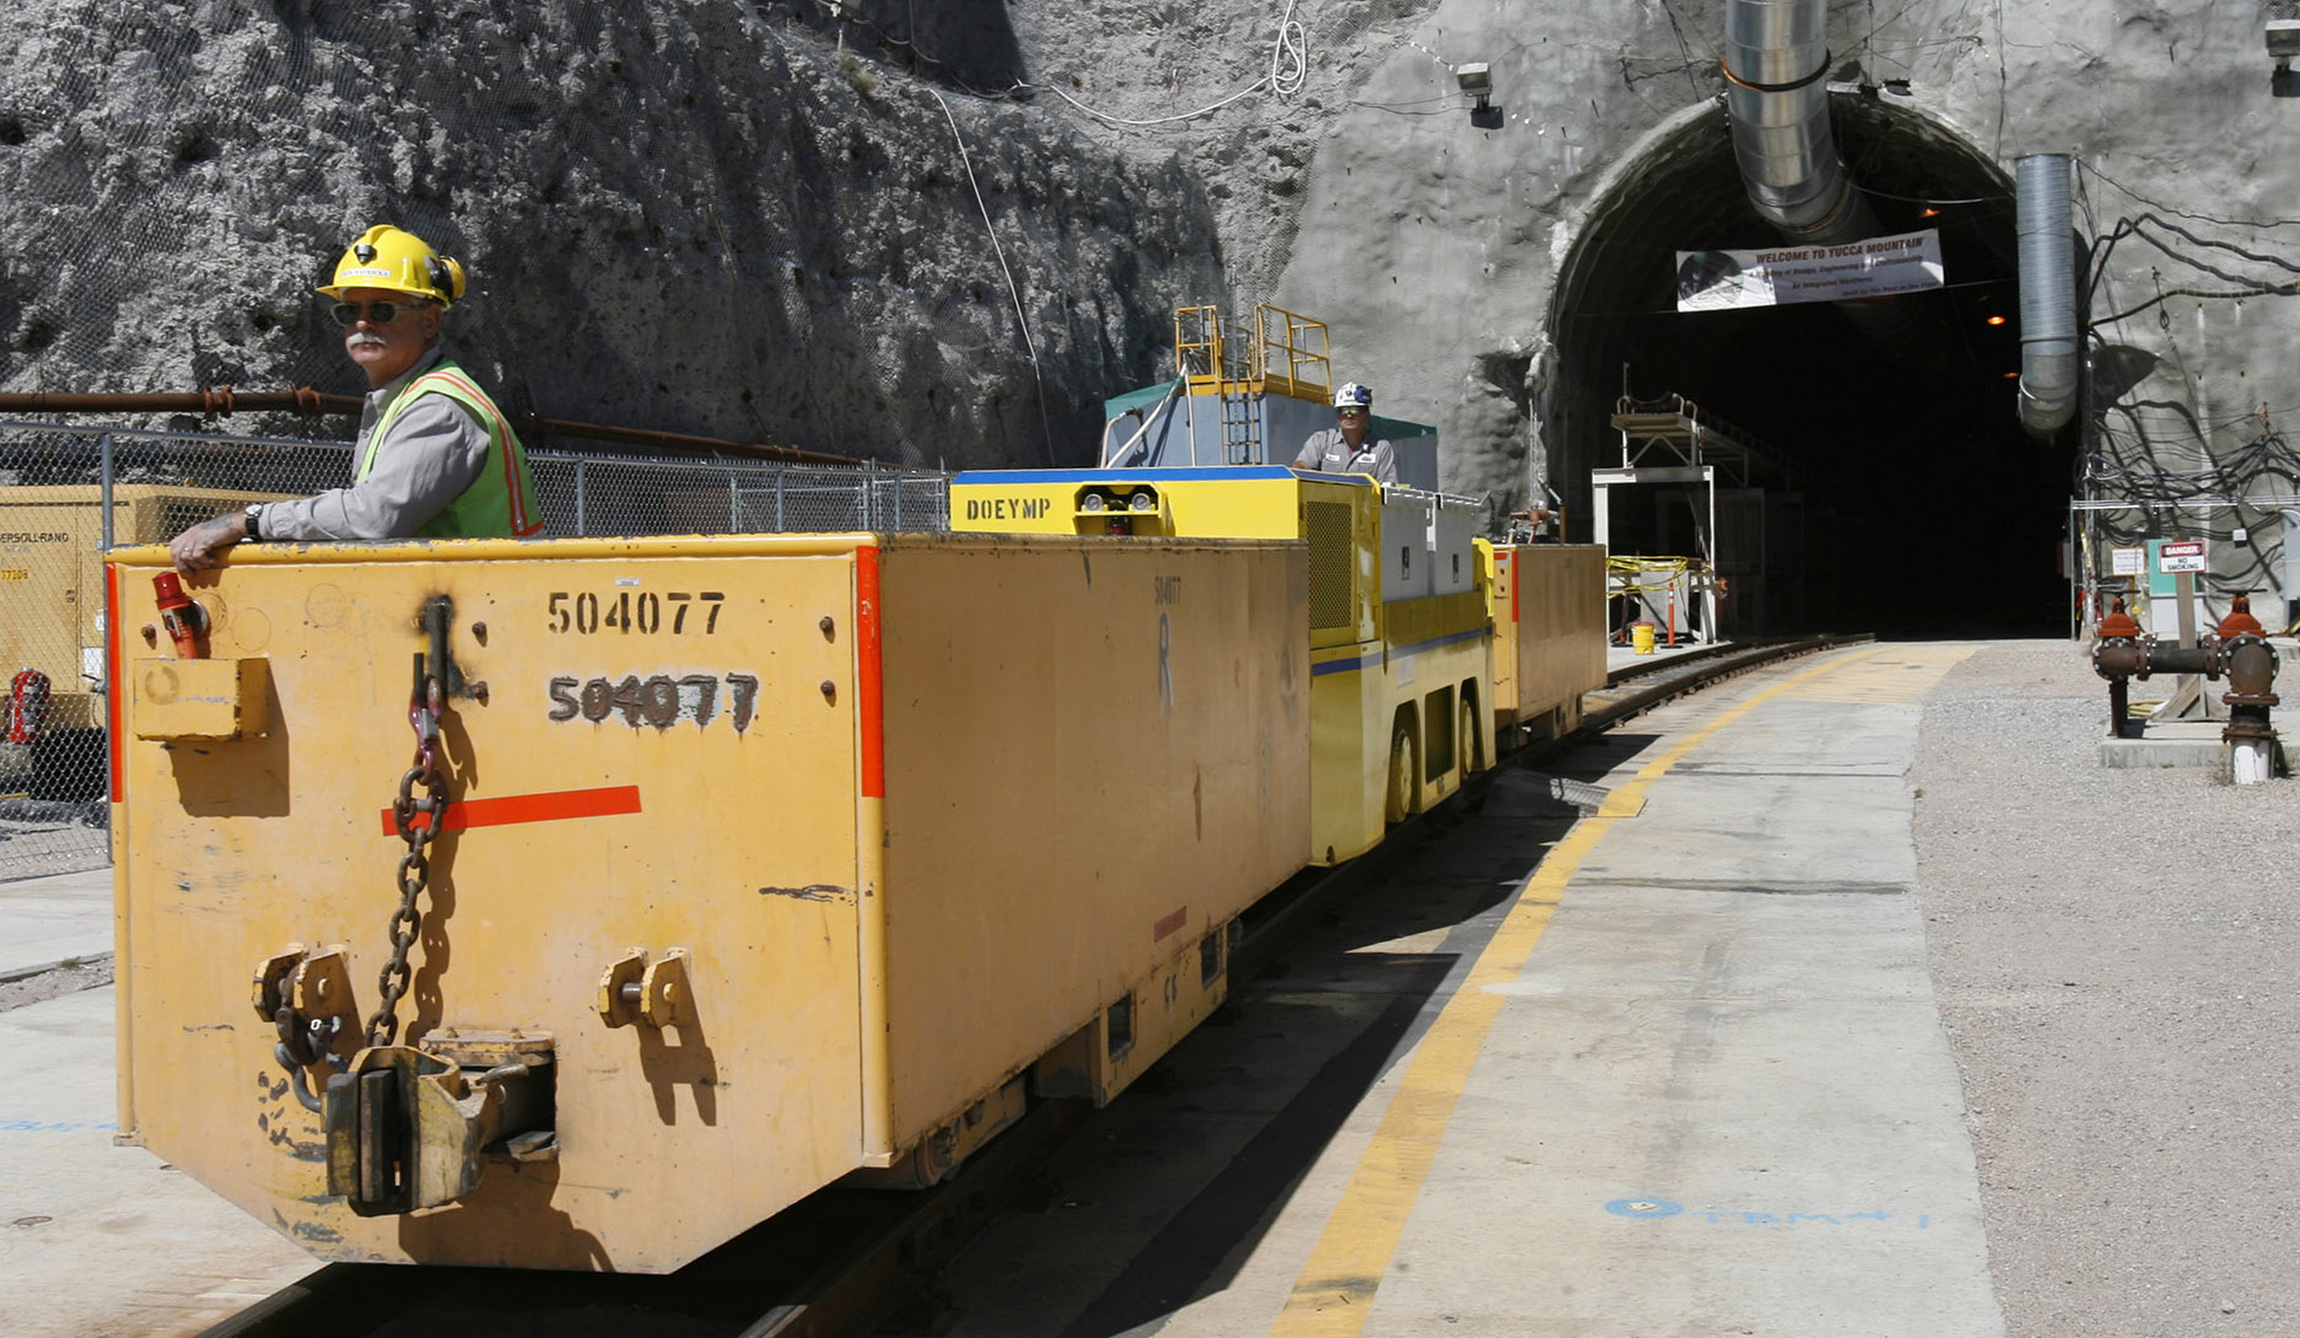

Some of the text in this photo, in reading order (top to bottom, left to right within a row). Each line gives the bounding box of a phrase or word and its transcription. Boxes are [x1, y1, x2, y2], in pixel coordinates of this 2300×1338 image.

[1756, 237, 1924, 264] WELCOME TO YUCCA MOUNTAIN
[966, 497, 1051, 520] DOEYMP
[0, 532, 69, 543] ERSOLL-RAND
[2165, 545, 2198, 556] DANGER
[2167, 563, 2199, 571] SMOKING
[548, 592, 725, 635] 504077
[548, 673, 759, 733] 504077
